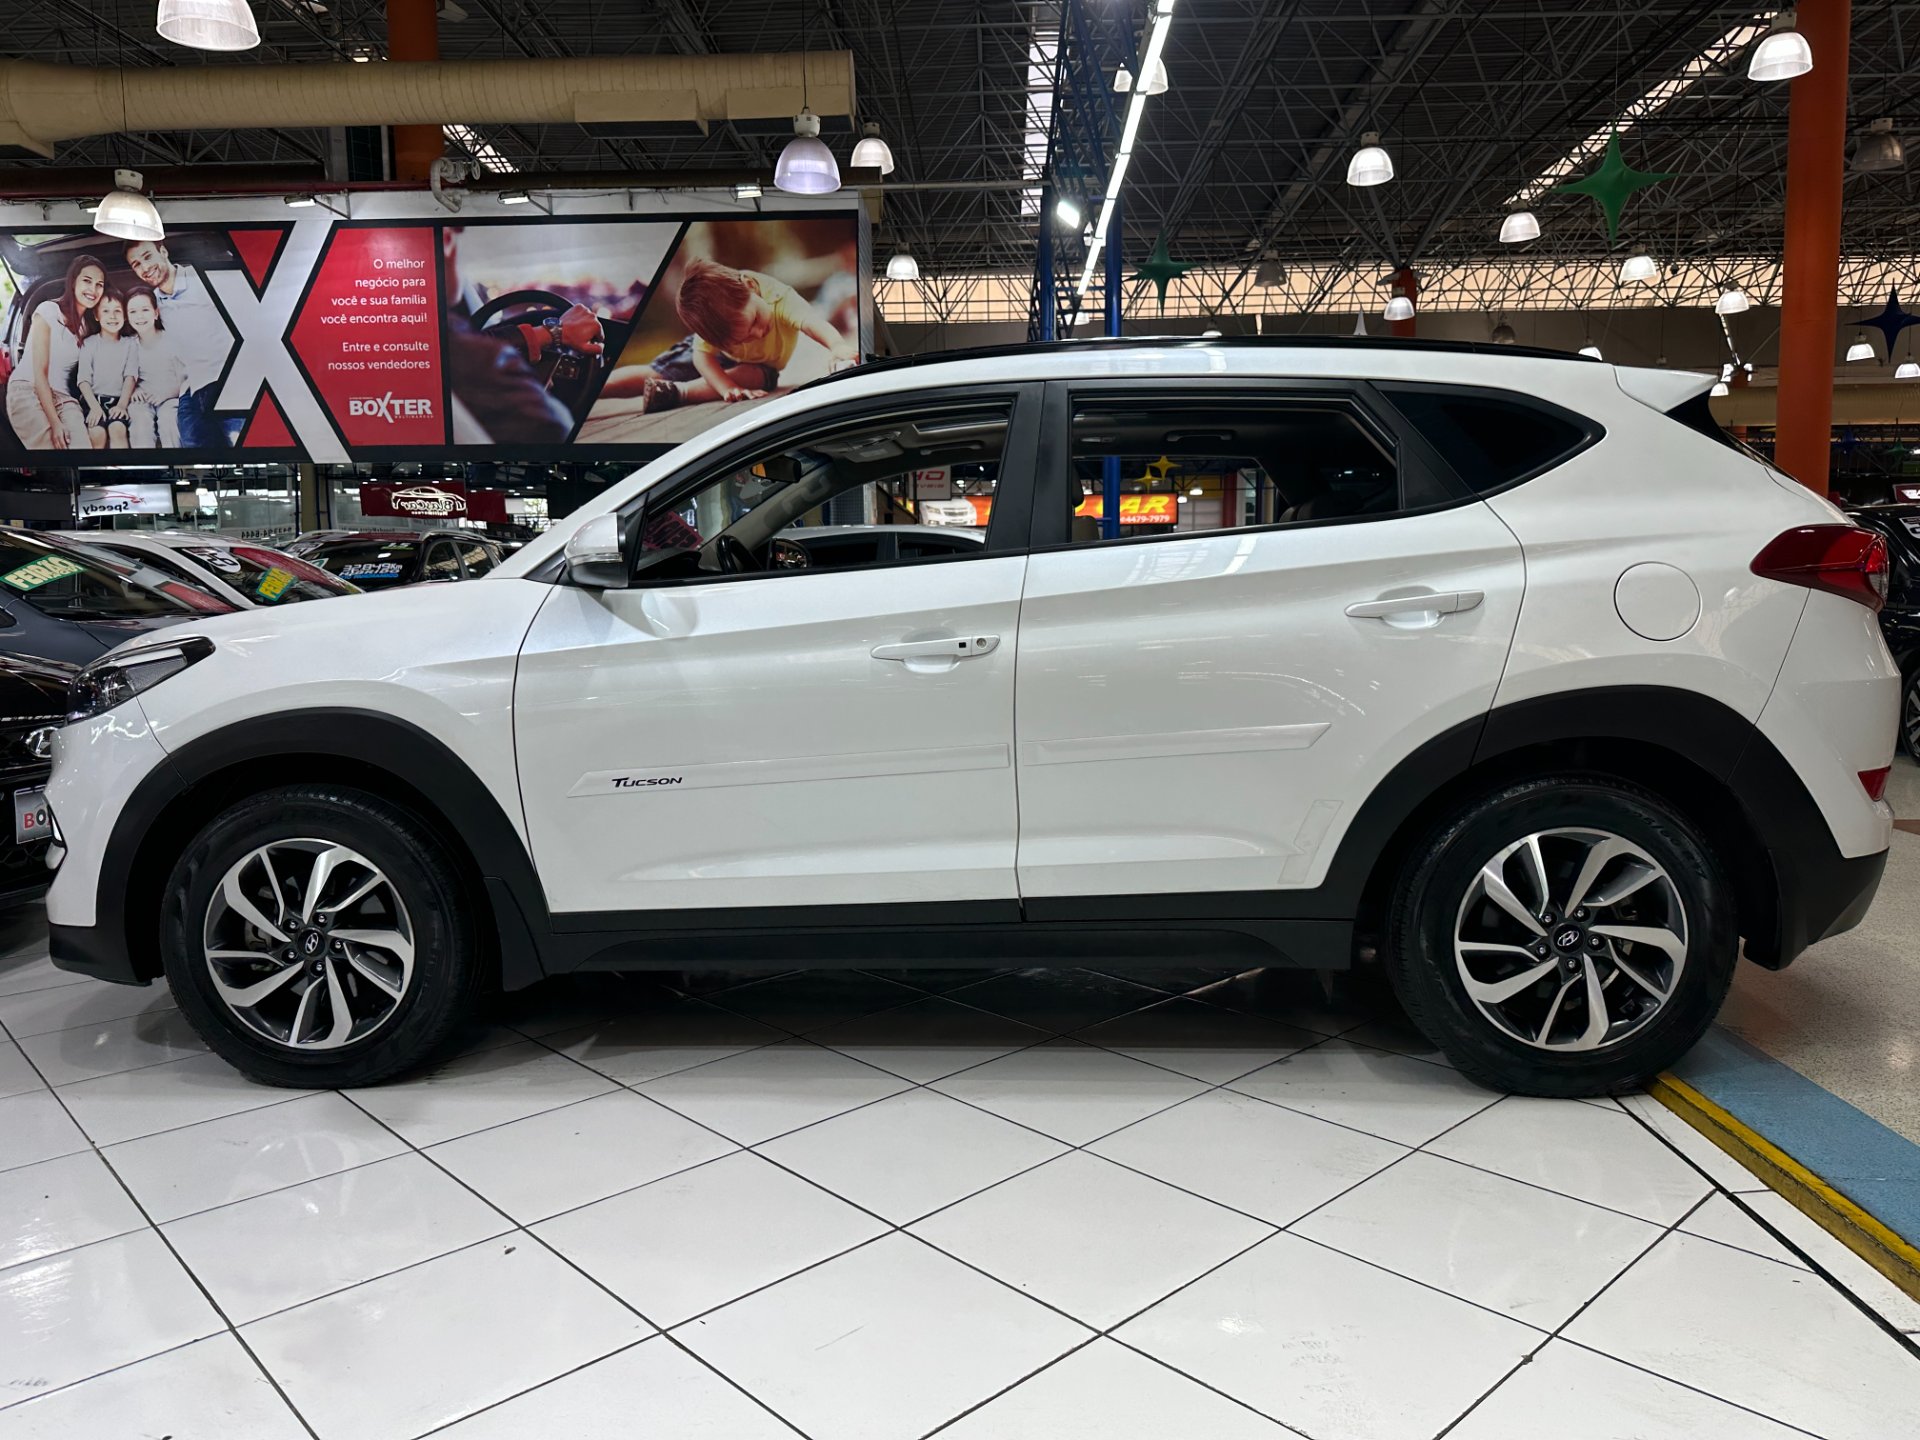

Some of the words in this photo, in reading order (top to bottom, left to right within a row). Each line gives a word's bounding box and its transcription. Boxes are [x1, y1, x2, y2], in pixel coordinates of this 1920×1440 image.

[373, 258, 384, 269] O
[386, 258, 425, 269] melhor
[355, 277, 399, 289] negócio
[402, 278, 426, 289] para
[331, 295, 358, 306] você
[360, 297, 367, 305] e
[369, 297, 388, 305] sua
[391, 294, 427, 305] família
[320, 313, 347, 324] você
[349, 314, 398, 324] encontra
[400, 313, 428, 325] aqui!
[342, 342, 371, 352] Entre
[373, 344, 380, 352] e
[382, 341, 430, 351] consulte
[328, 361, 365, 371] nossos
[367, 359, 430, 370] vendedores
[349, 391, 433, 423] BOXTER
[23, 808, 51, 830] BO
